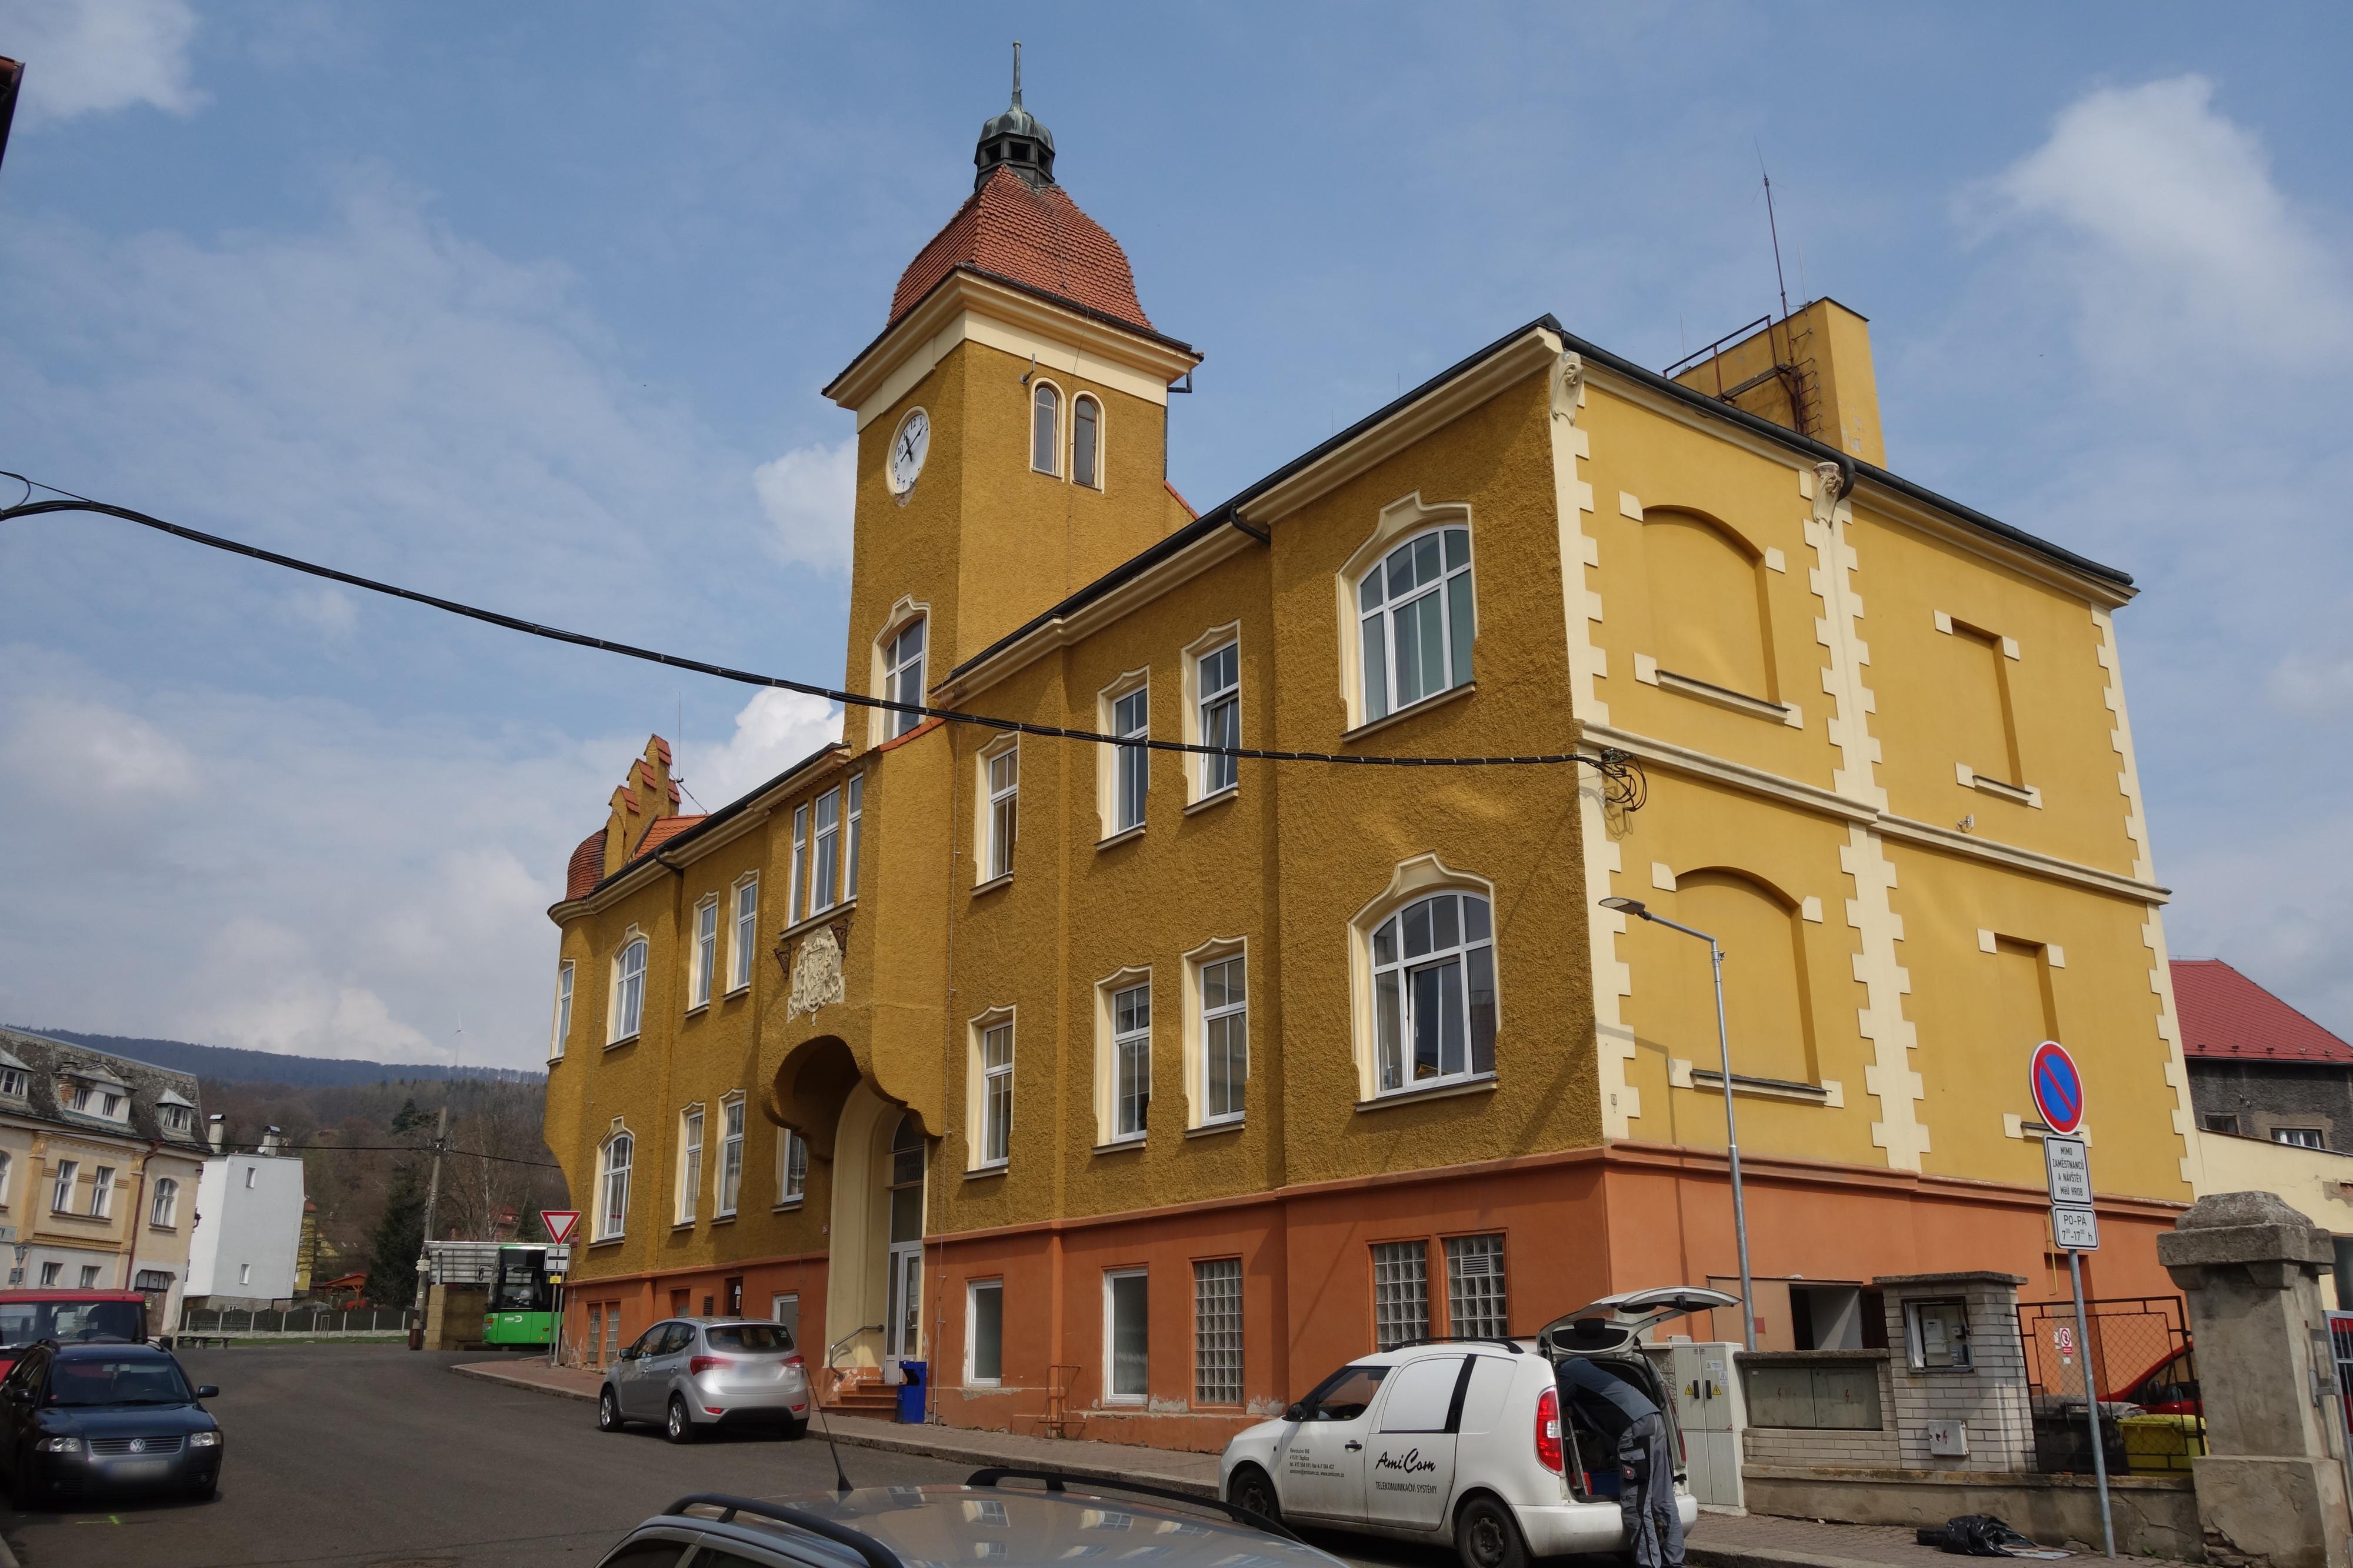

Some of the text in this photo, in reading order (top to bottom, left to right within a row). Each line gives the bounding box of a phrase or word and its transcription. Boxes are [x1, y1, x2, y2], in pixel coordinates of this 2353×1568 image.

[910, 418, 916, 431] 12
[919, 416, 922, 426] 1
[925, 422, 928, 432] 2
[897, 445, 904, 456] 10
[894, 462, 898, 472] 9
[896, 474, 900, 484] 8
[902, 479, 906, 489] 7
[2060, 1146, 2073, 1156] MIMO
[2052, 1157, 2084, 1170] ZAMĚSTNANCŮ
[2058, 1171, 2082, 1183] A NÁVŠTĚV
[2071, 1186, 2084, 1196] HROB
[2064, 1213, 2087, 1226] PO-PÁ
[2088, 1232, 2093, 1242] h
[1375, 1448, 1436, 1473] AmiCom
[1375, 1481, 1437, 1494] TELEKOMUNIKAČNÍ SYSTÉMY
